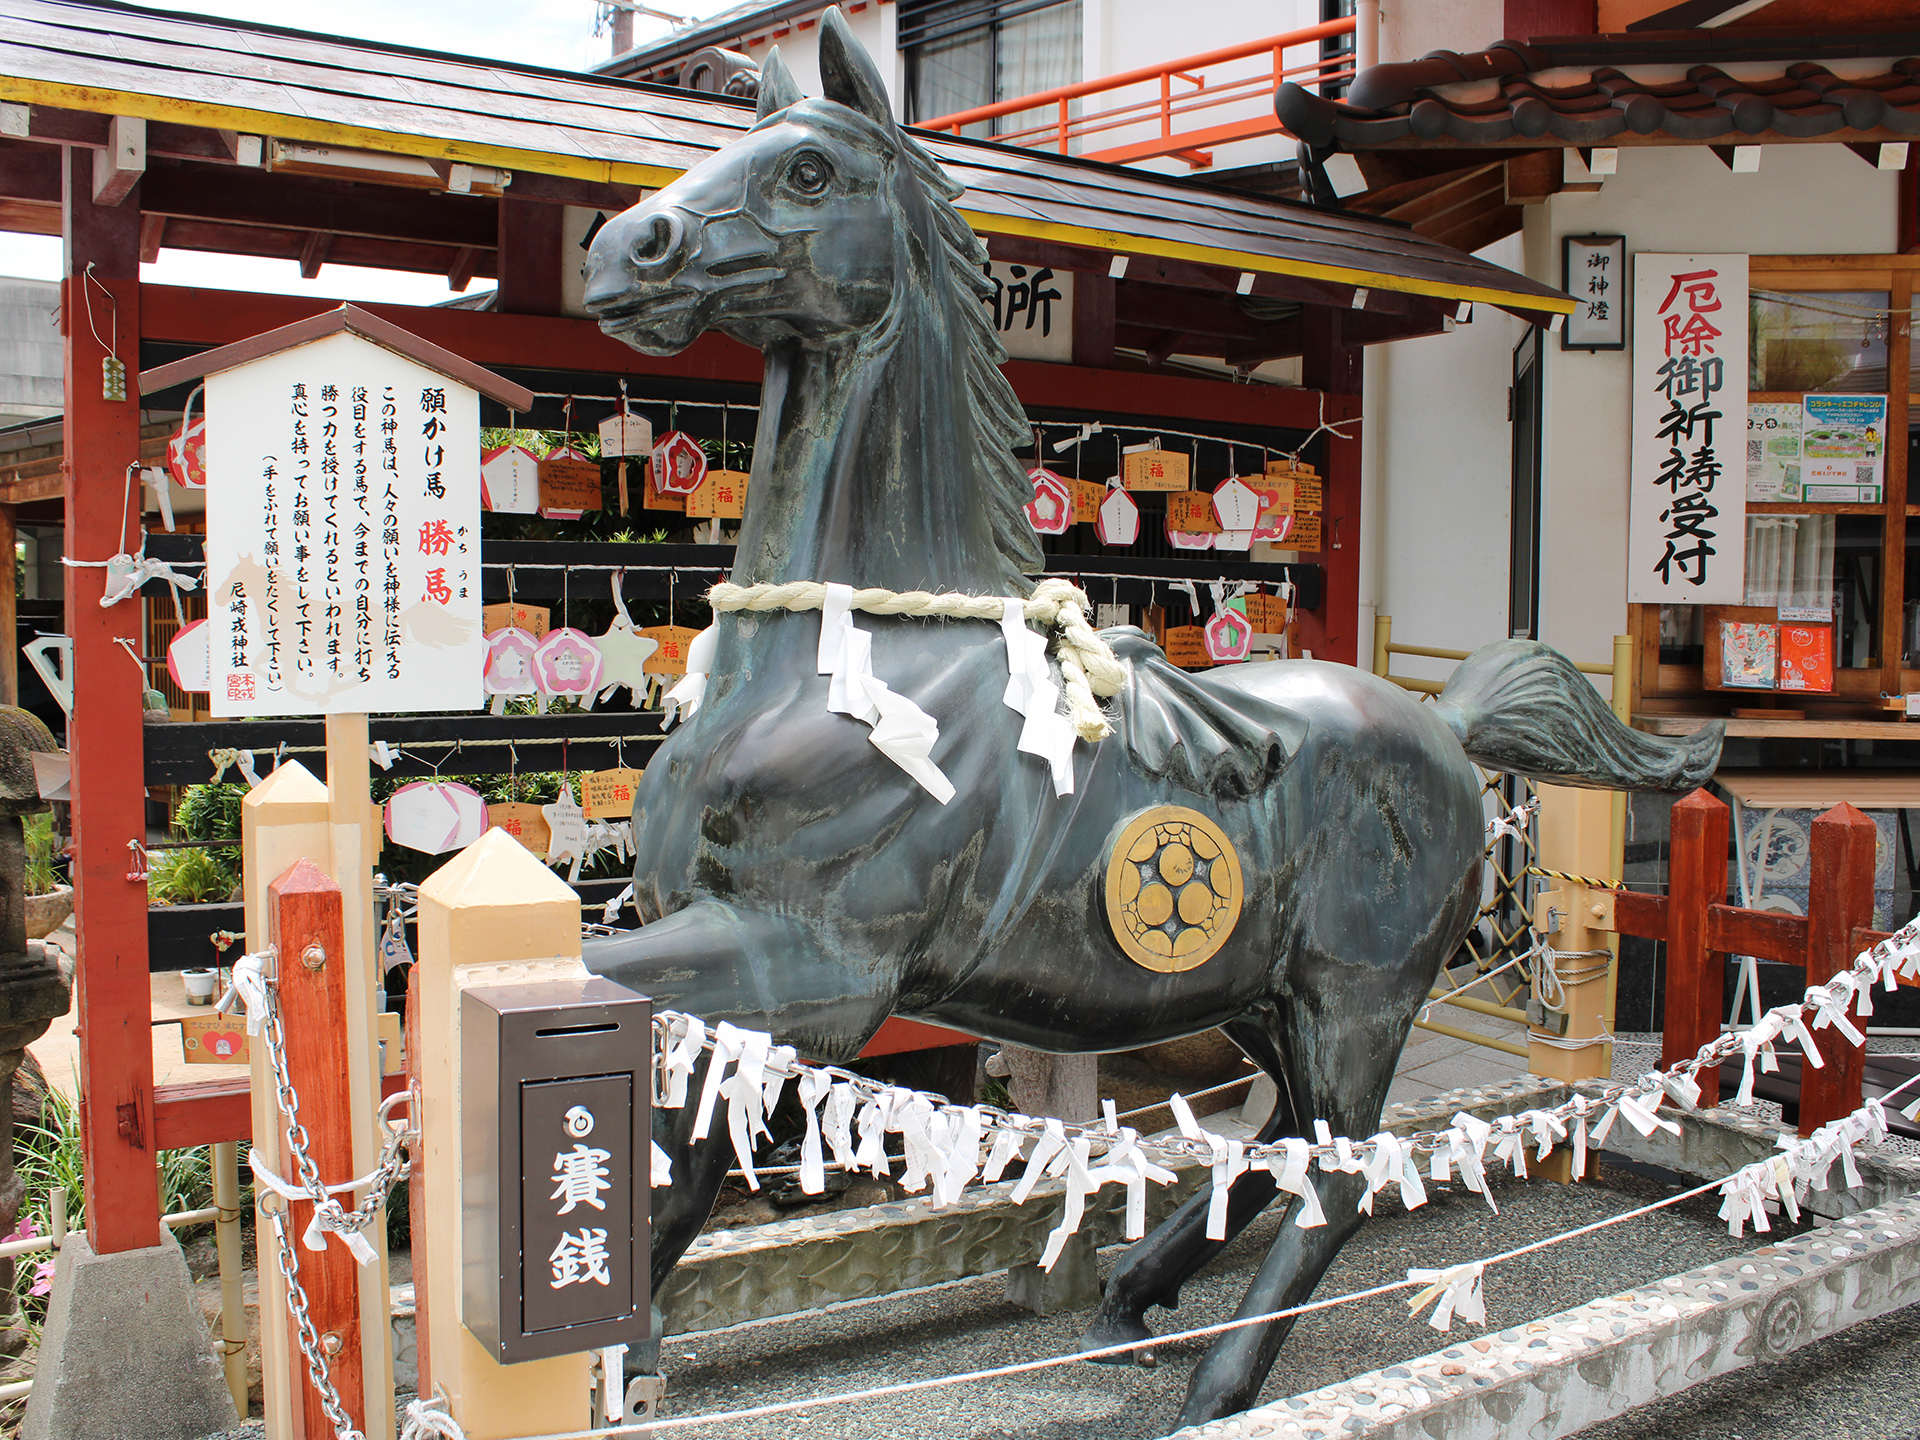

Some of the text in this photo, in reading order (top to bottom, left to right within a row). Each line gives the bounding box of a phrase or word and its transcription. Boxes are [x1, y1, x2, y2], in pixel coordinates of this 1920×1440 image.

[1587, 253, 1611, 321] 御神燈
[1653, 268, 1725, 588] 厄除御祈祷受付
[418, 387, 456, 606] 願かけ馬 勝馬
[716, 486, 734, 503] 福
[1149, 463, 1164, 478] 福
[1190, 504, 1202, 518] 福
[290, 382, 314, 678] 真心を持ってお願い事をして下さい。
[320, 384, 344, 678] 勝つ力を授けてくれるといわれます。
[350, 386, 373, 683] 役目をする馬で、今までの自分に打ち
[380, 386, 401, 680] この神馬は、人々の願いを神様に伝える
[457, 525, 469, 600] かち うま
[229, 582, 249, 669] 尼崎戎神社
[662, 641, 679, 658] 福
[505, 818, 522, 836] 福
[612, 784, 631, 801] 福
[549, 1144, 613, 1289] 賽銭
